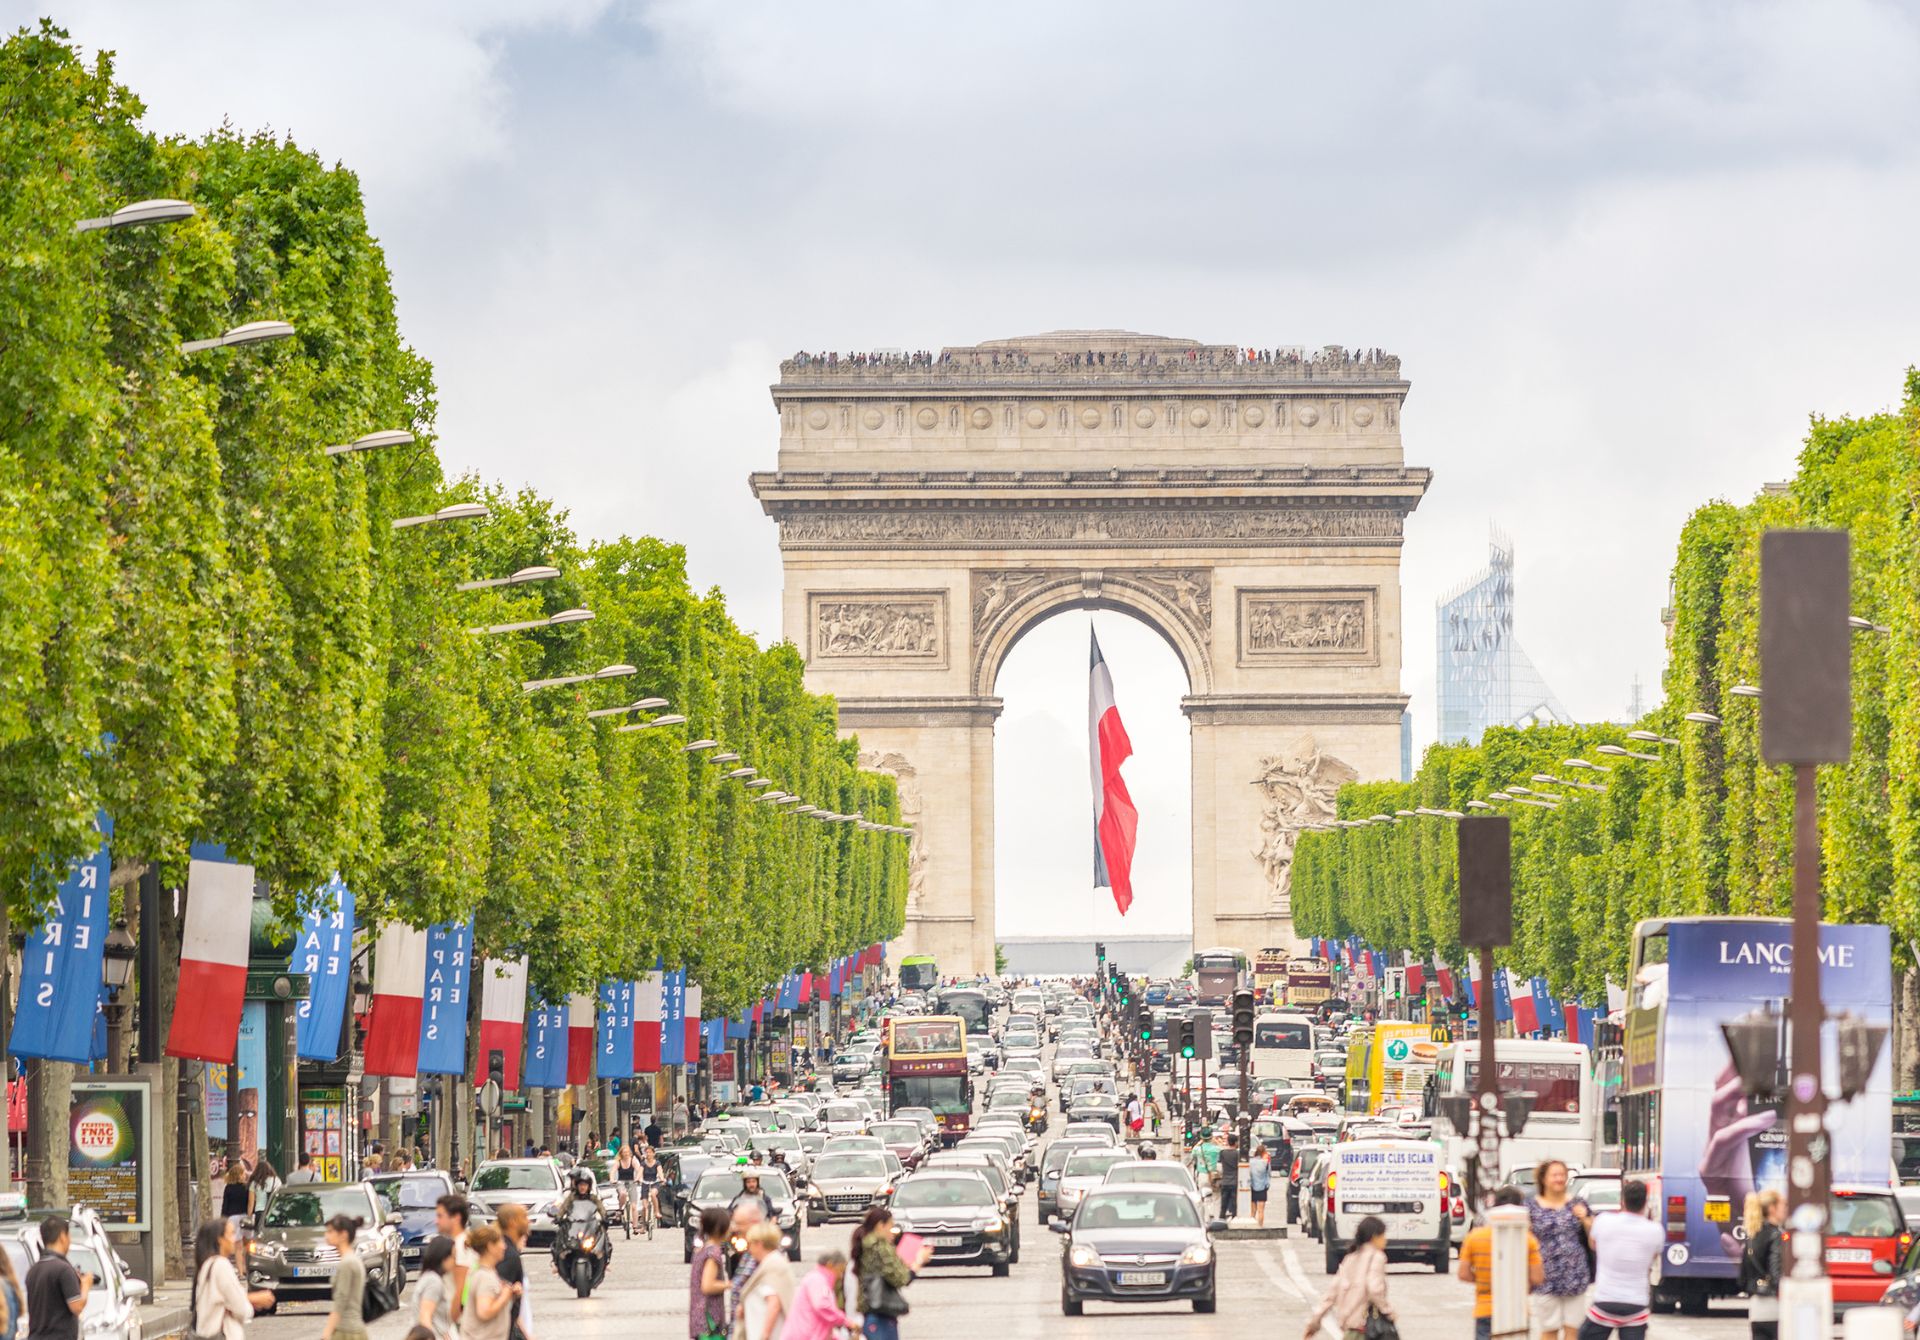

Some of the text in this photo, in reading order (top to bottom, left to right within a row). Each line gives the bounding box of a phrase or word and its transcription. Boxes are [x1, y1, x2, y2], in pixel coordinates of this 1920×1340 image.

[1720, 941, 1855, 968] LANCME
[1769, 965, 1795, 974] PAR
[81, 1128, 114, 1136] FNAC
[81, 1136, 114, 1145] LIVE
[1341, 1153, 1385, 1164] SERRURERIE
[1671, 1249, 1684, 1261] 70
